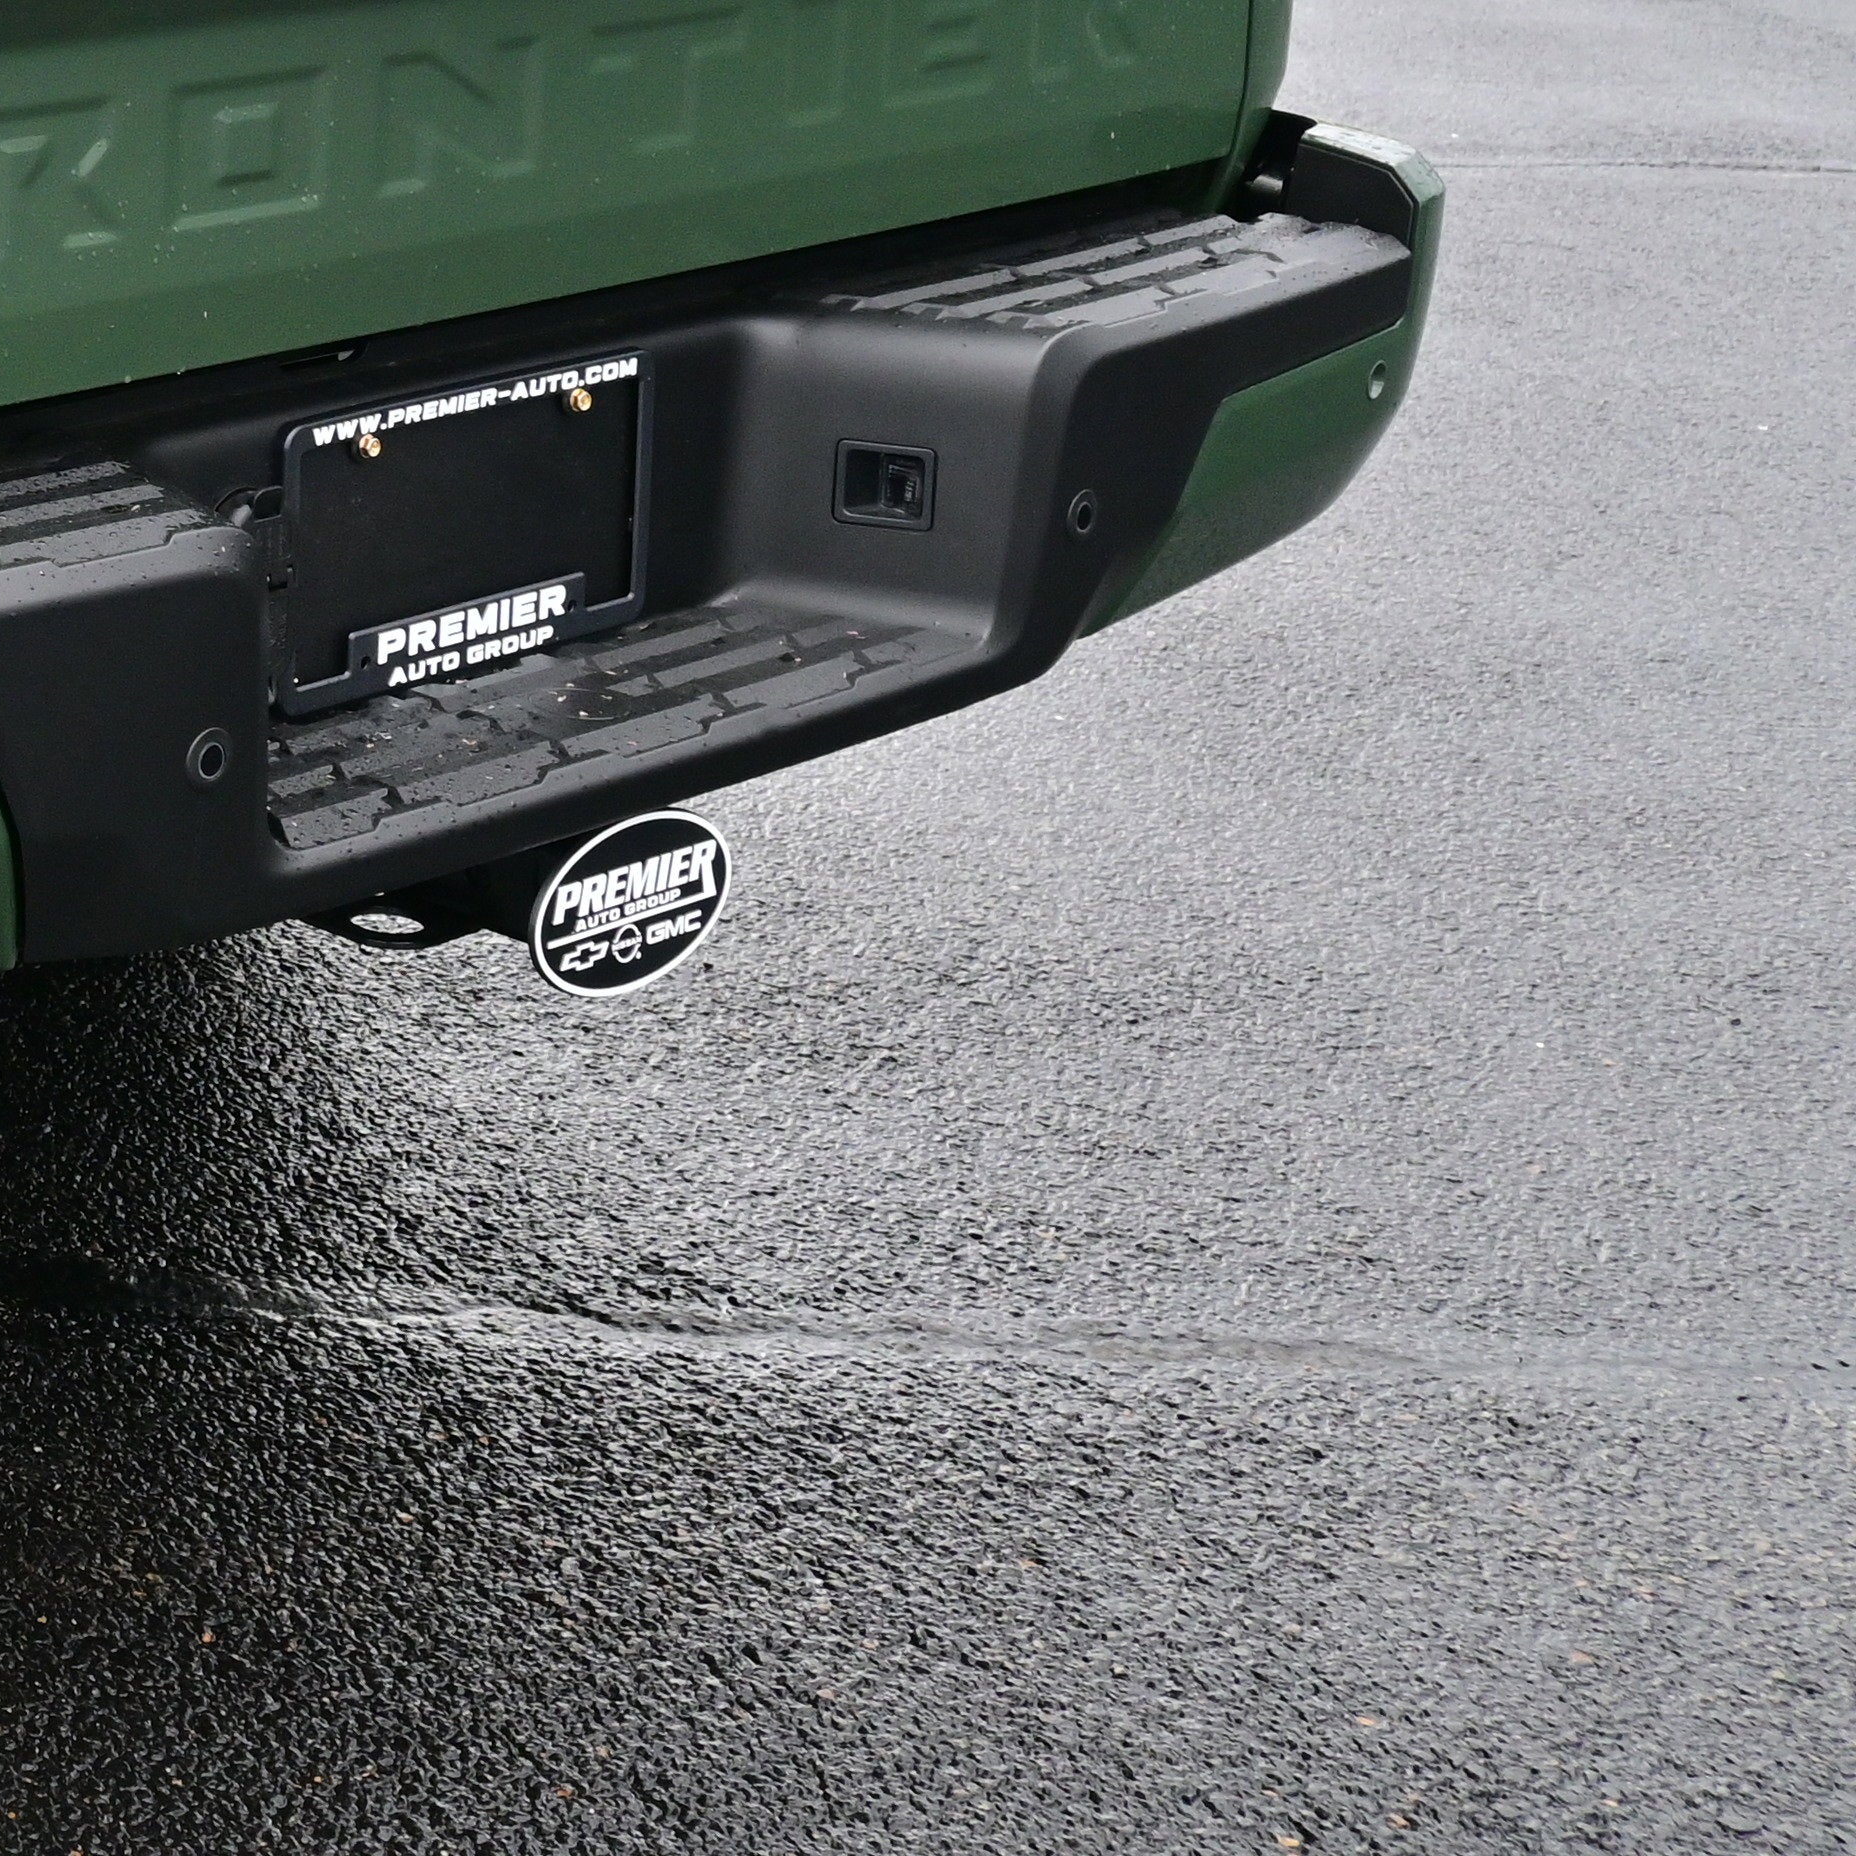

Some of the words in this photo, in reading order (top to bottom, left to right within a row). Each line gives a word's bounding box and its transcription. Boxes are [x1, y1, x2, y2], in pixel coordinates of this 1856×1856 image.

[312, 357, 638, 447] WWW.PREMIER-AUTO.COM
[377, 583, 568, 666] PREMIER
[388, 650, 461, 688] AUTO
[466, 624, 554, 664] GROUP
[552, 838, 717, 926] PREMIER
[574, 909, 622, 933] AUTO
[624, 888, 682, 916] GROUP
[646, 909, 703, 945] GMC
